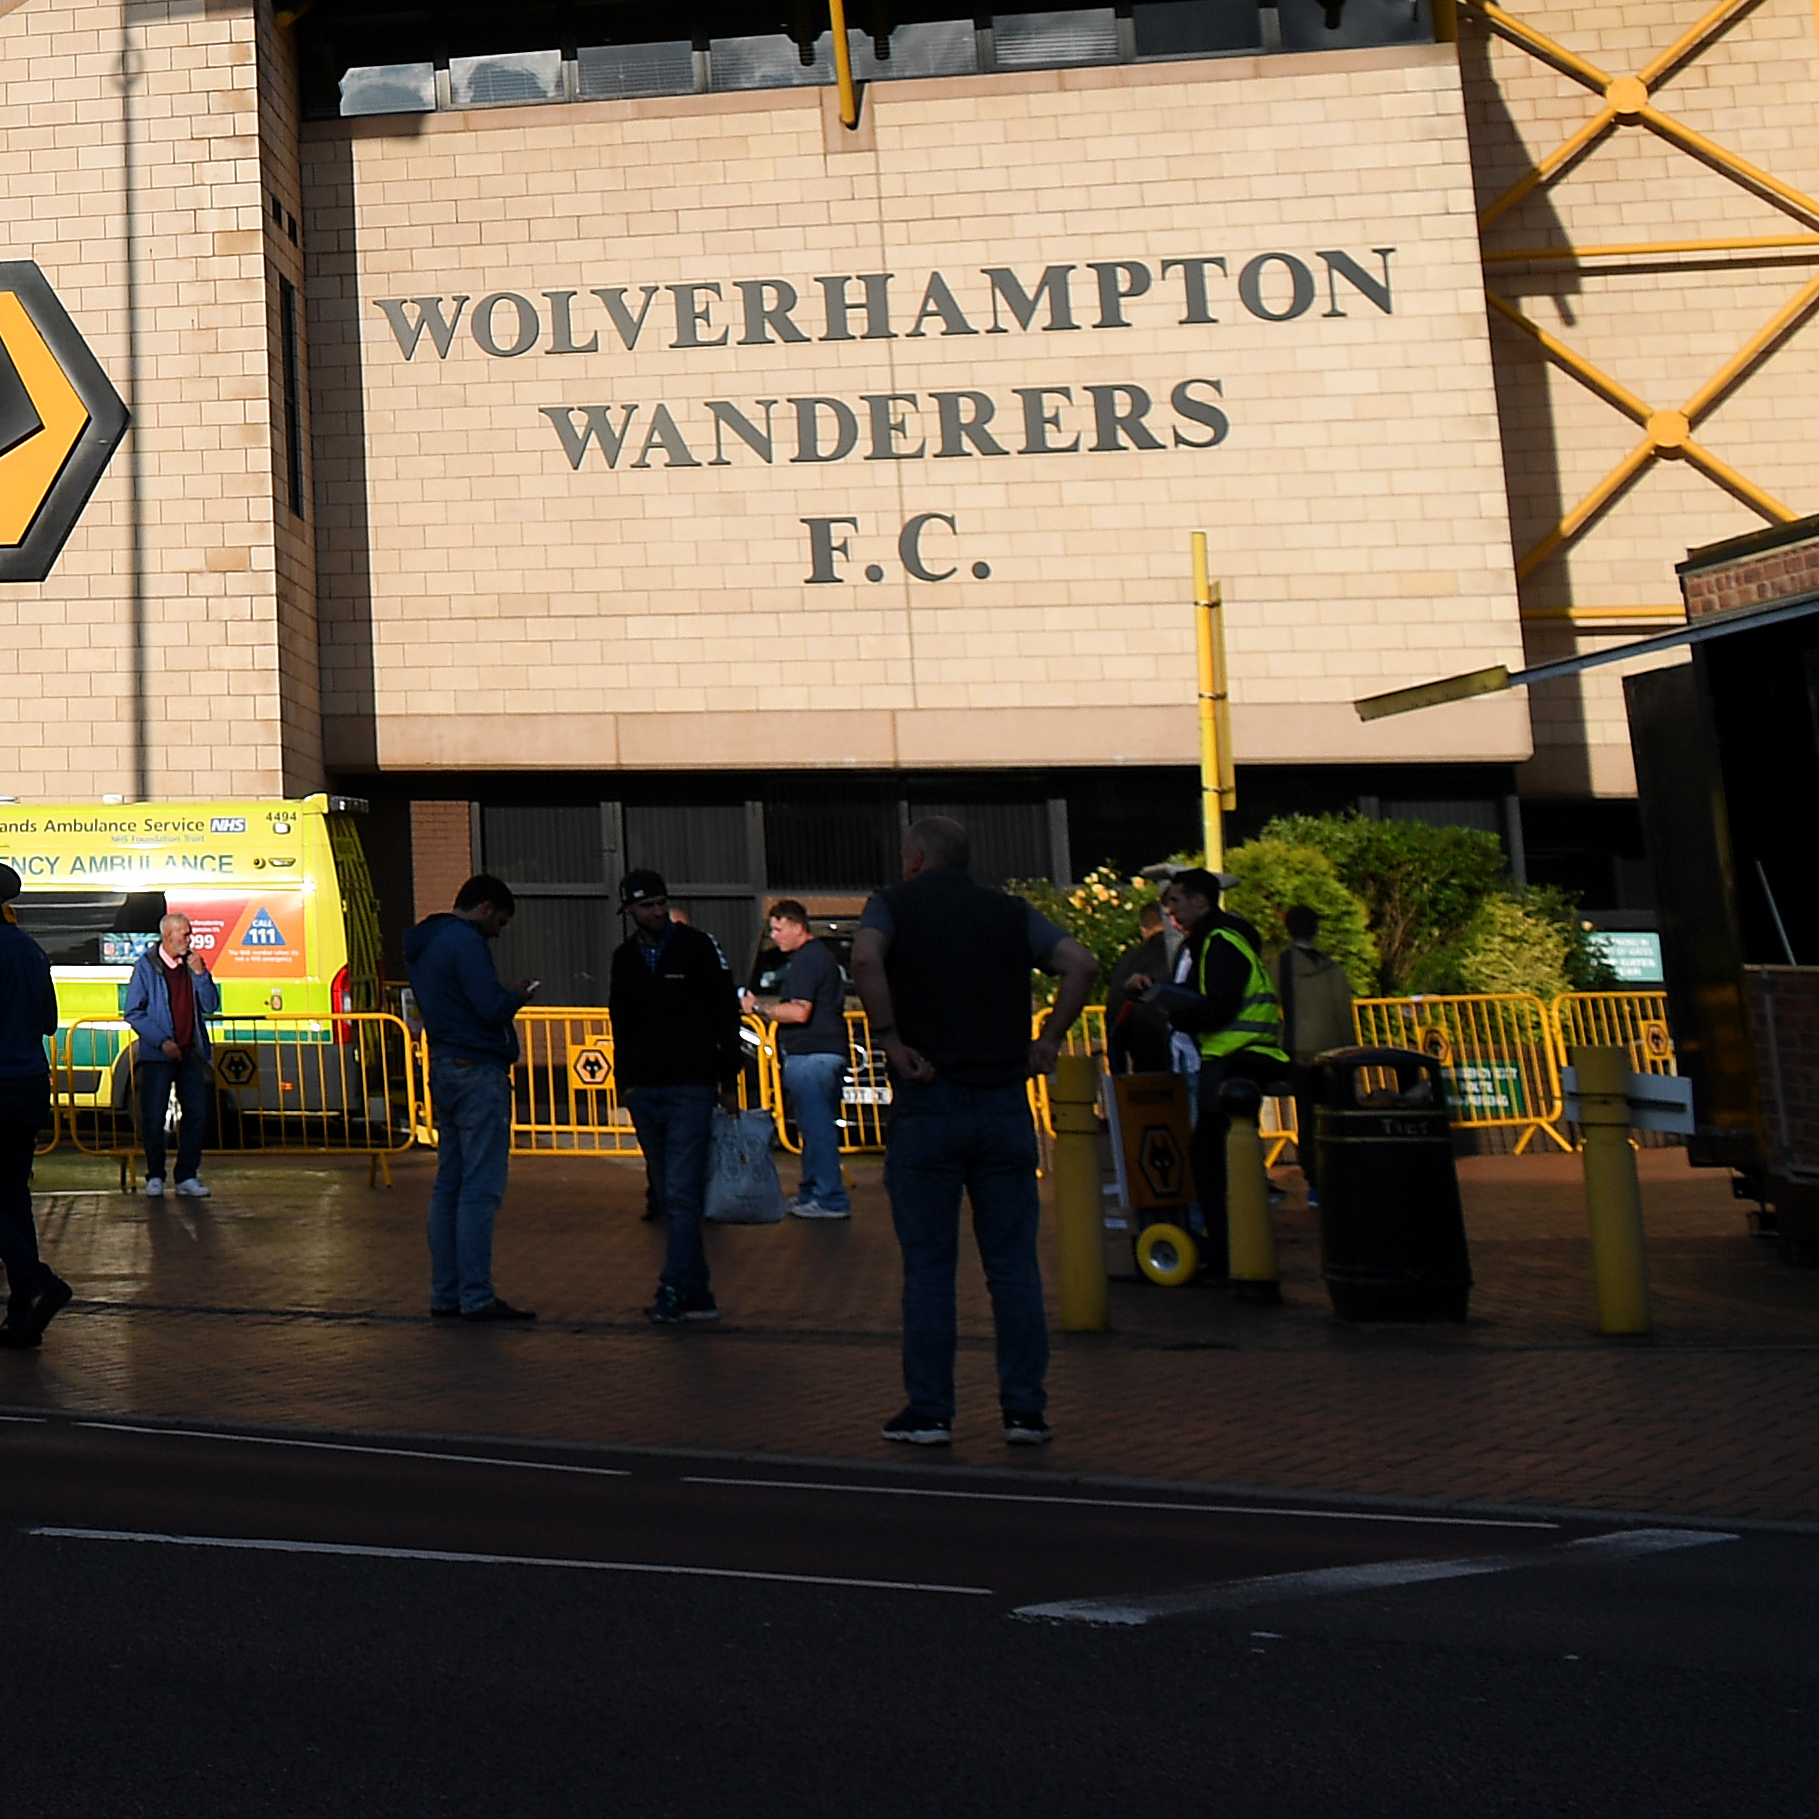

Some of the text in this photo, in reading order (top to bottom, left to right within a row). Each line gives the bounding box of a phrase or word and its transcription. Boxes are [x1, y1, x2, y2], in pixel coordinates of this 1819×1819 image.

[373, 246, 1397, 362] WOLVERHAMPTON
[539, 377, 1231, 470] WANDERERS
[799, 511, 993, 584] F.C.
[265, 811, 297, 821] 4494
[43, 818, 137, 833] Ambulance
[144, 818, 205, 832] Service
[211, 818, 246, 832] NHS
[253, 919, 273, 927] CALL
[249, 929, 276, 944] 111
